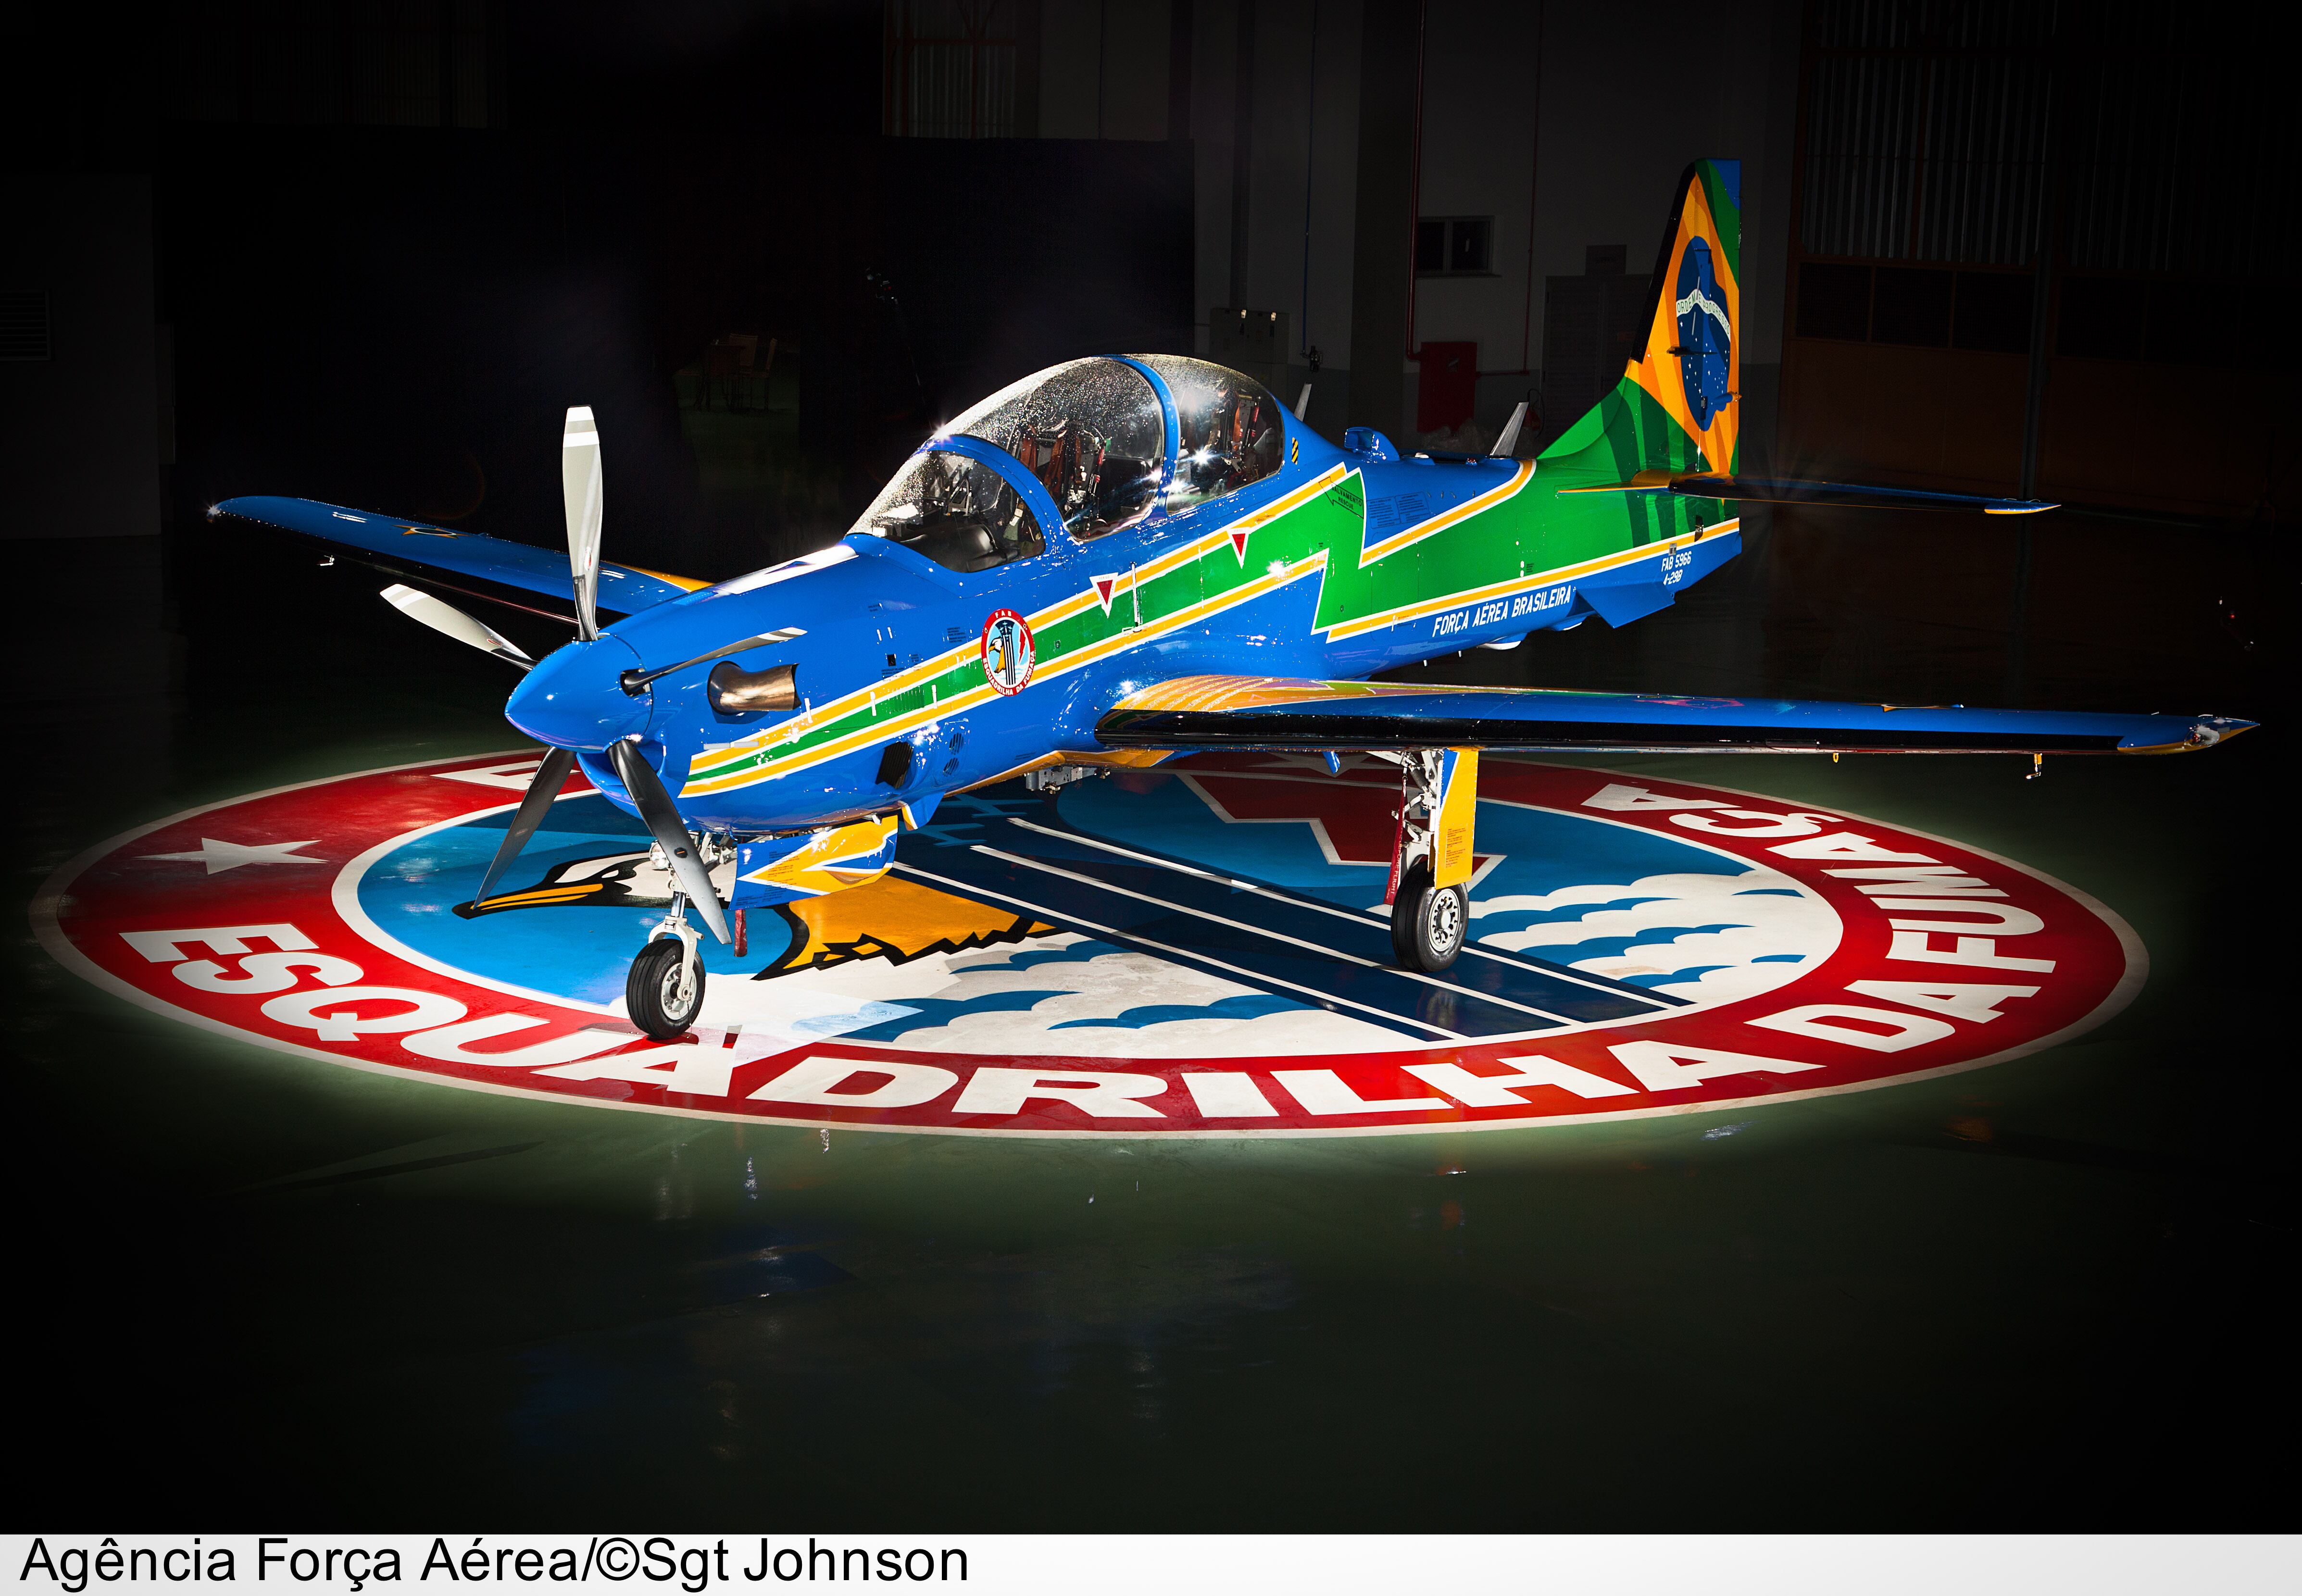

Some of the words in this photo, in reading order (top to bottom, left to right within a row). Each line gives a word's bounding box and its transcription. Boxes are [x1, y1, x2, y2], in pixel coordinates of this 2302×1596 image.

[1677, 291, 1696, 313] ORDEM
[1699, 293, 1701, 304] E
[1703, 300, 1729, 335] PROGRESSO
[1332, 484, 1362, 507] SALVAMENTO
[1338, 497, 1354, 510] RESCUE
[1661, 556, 1674, 572] FAB
[1675, 551, 1692, 568] 5966
[995, 610, 1012, 619] FAB
[1432, 610, 1469, 637] FORÇA
[1472, 602, 1509, 627] AÉREA
[1512, 585, 1571, 618] BRASILEIRA
[983, 657, 1013, 696] ESQUADRILHA
[1016, 685, 1024, 693] DA
[1023, 650, 1035, 685] FUMAÇA
[1390, 870, 1399, 894] FLIGHT
[1580, 783, 2056, 973] FUMAÇA
[118, 923, 1827, 1119] ESQUADRILHA
[1744, 980, 2041, 1053] DA
